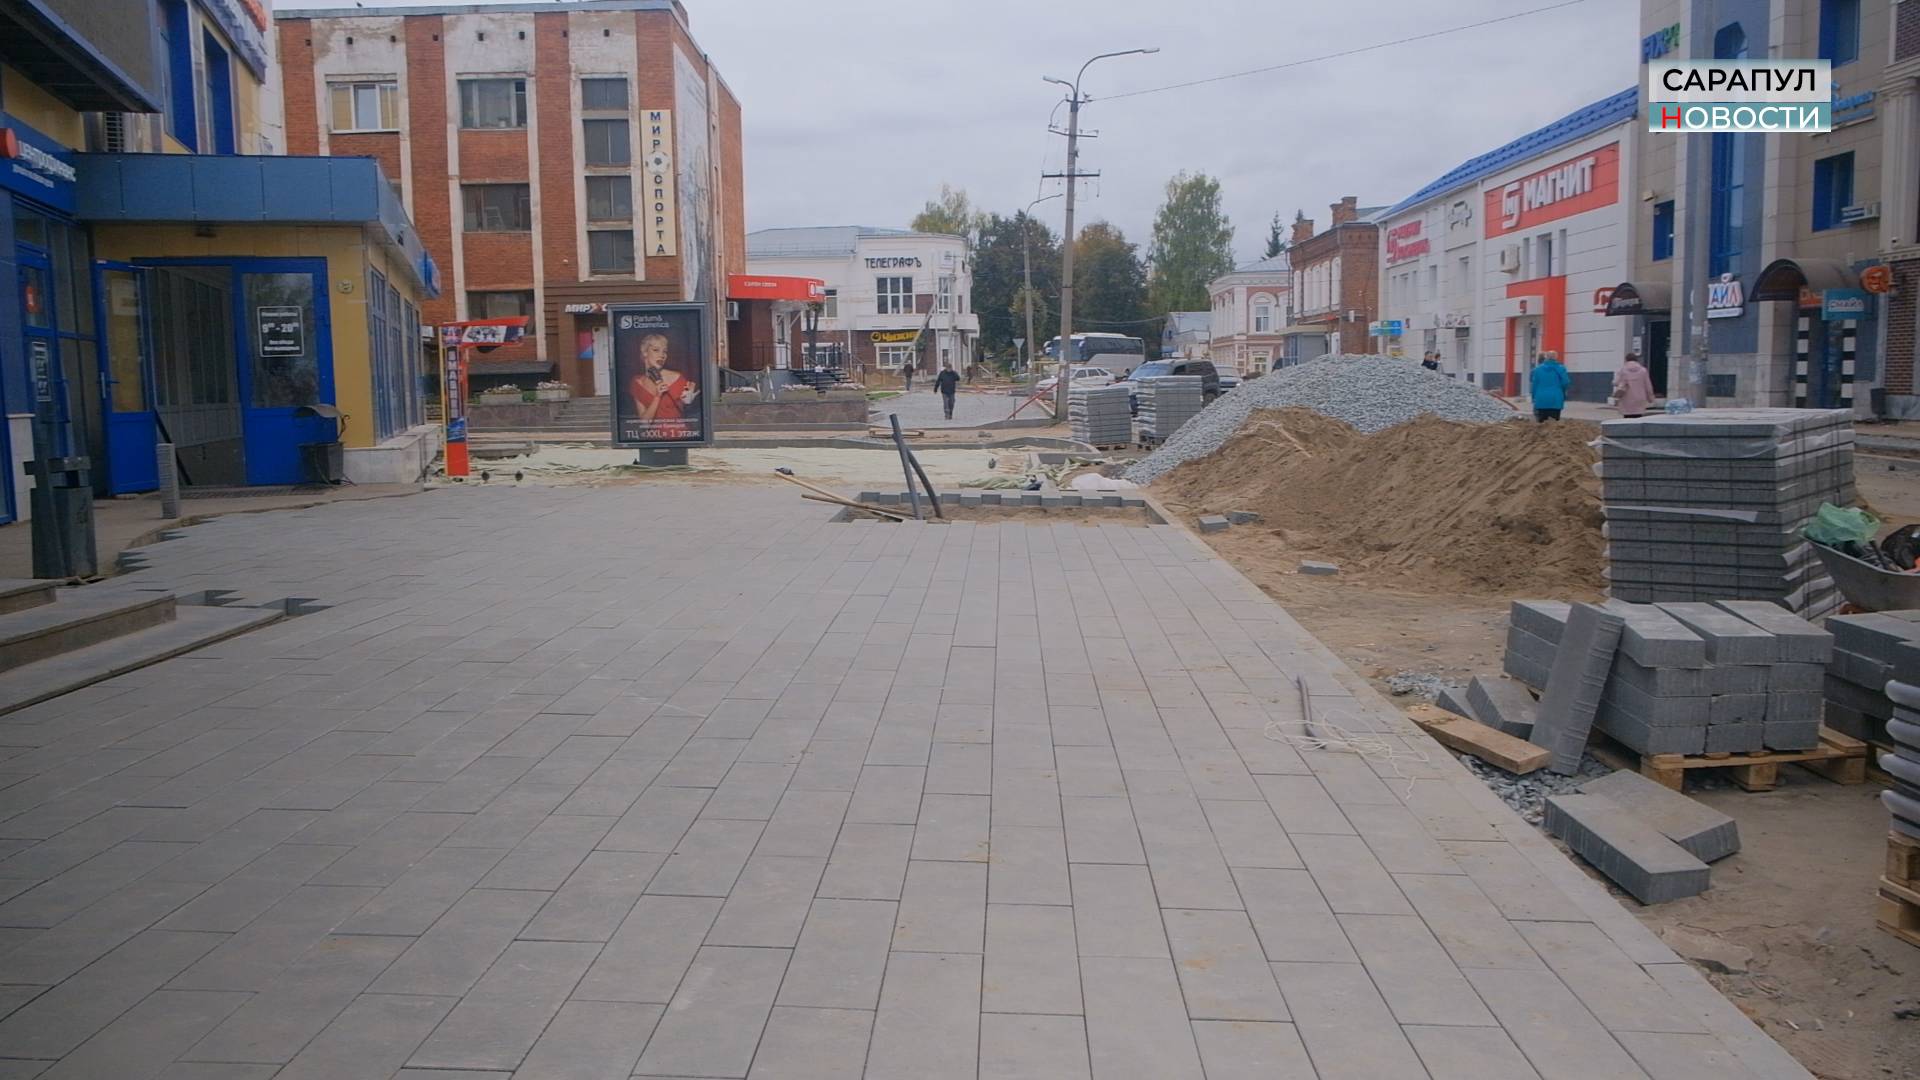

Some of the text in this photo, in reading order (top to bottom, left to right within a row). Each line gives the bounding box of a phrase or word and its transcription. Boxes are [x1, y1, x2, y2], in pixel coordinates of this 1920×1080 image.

[650, 111, 665, 254] МИР СПОРТА
[1523, 157, 1596, 212] МАГНИТ
[864, 257, 922, 269] ТЕЛЕГРАФЪ
[565, 303, 591, 313] МИР
[626, 430, 639, 439] ТЦ
[671, 429, 678, 438] 1
[680, 430, 700, 438] этаж
